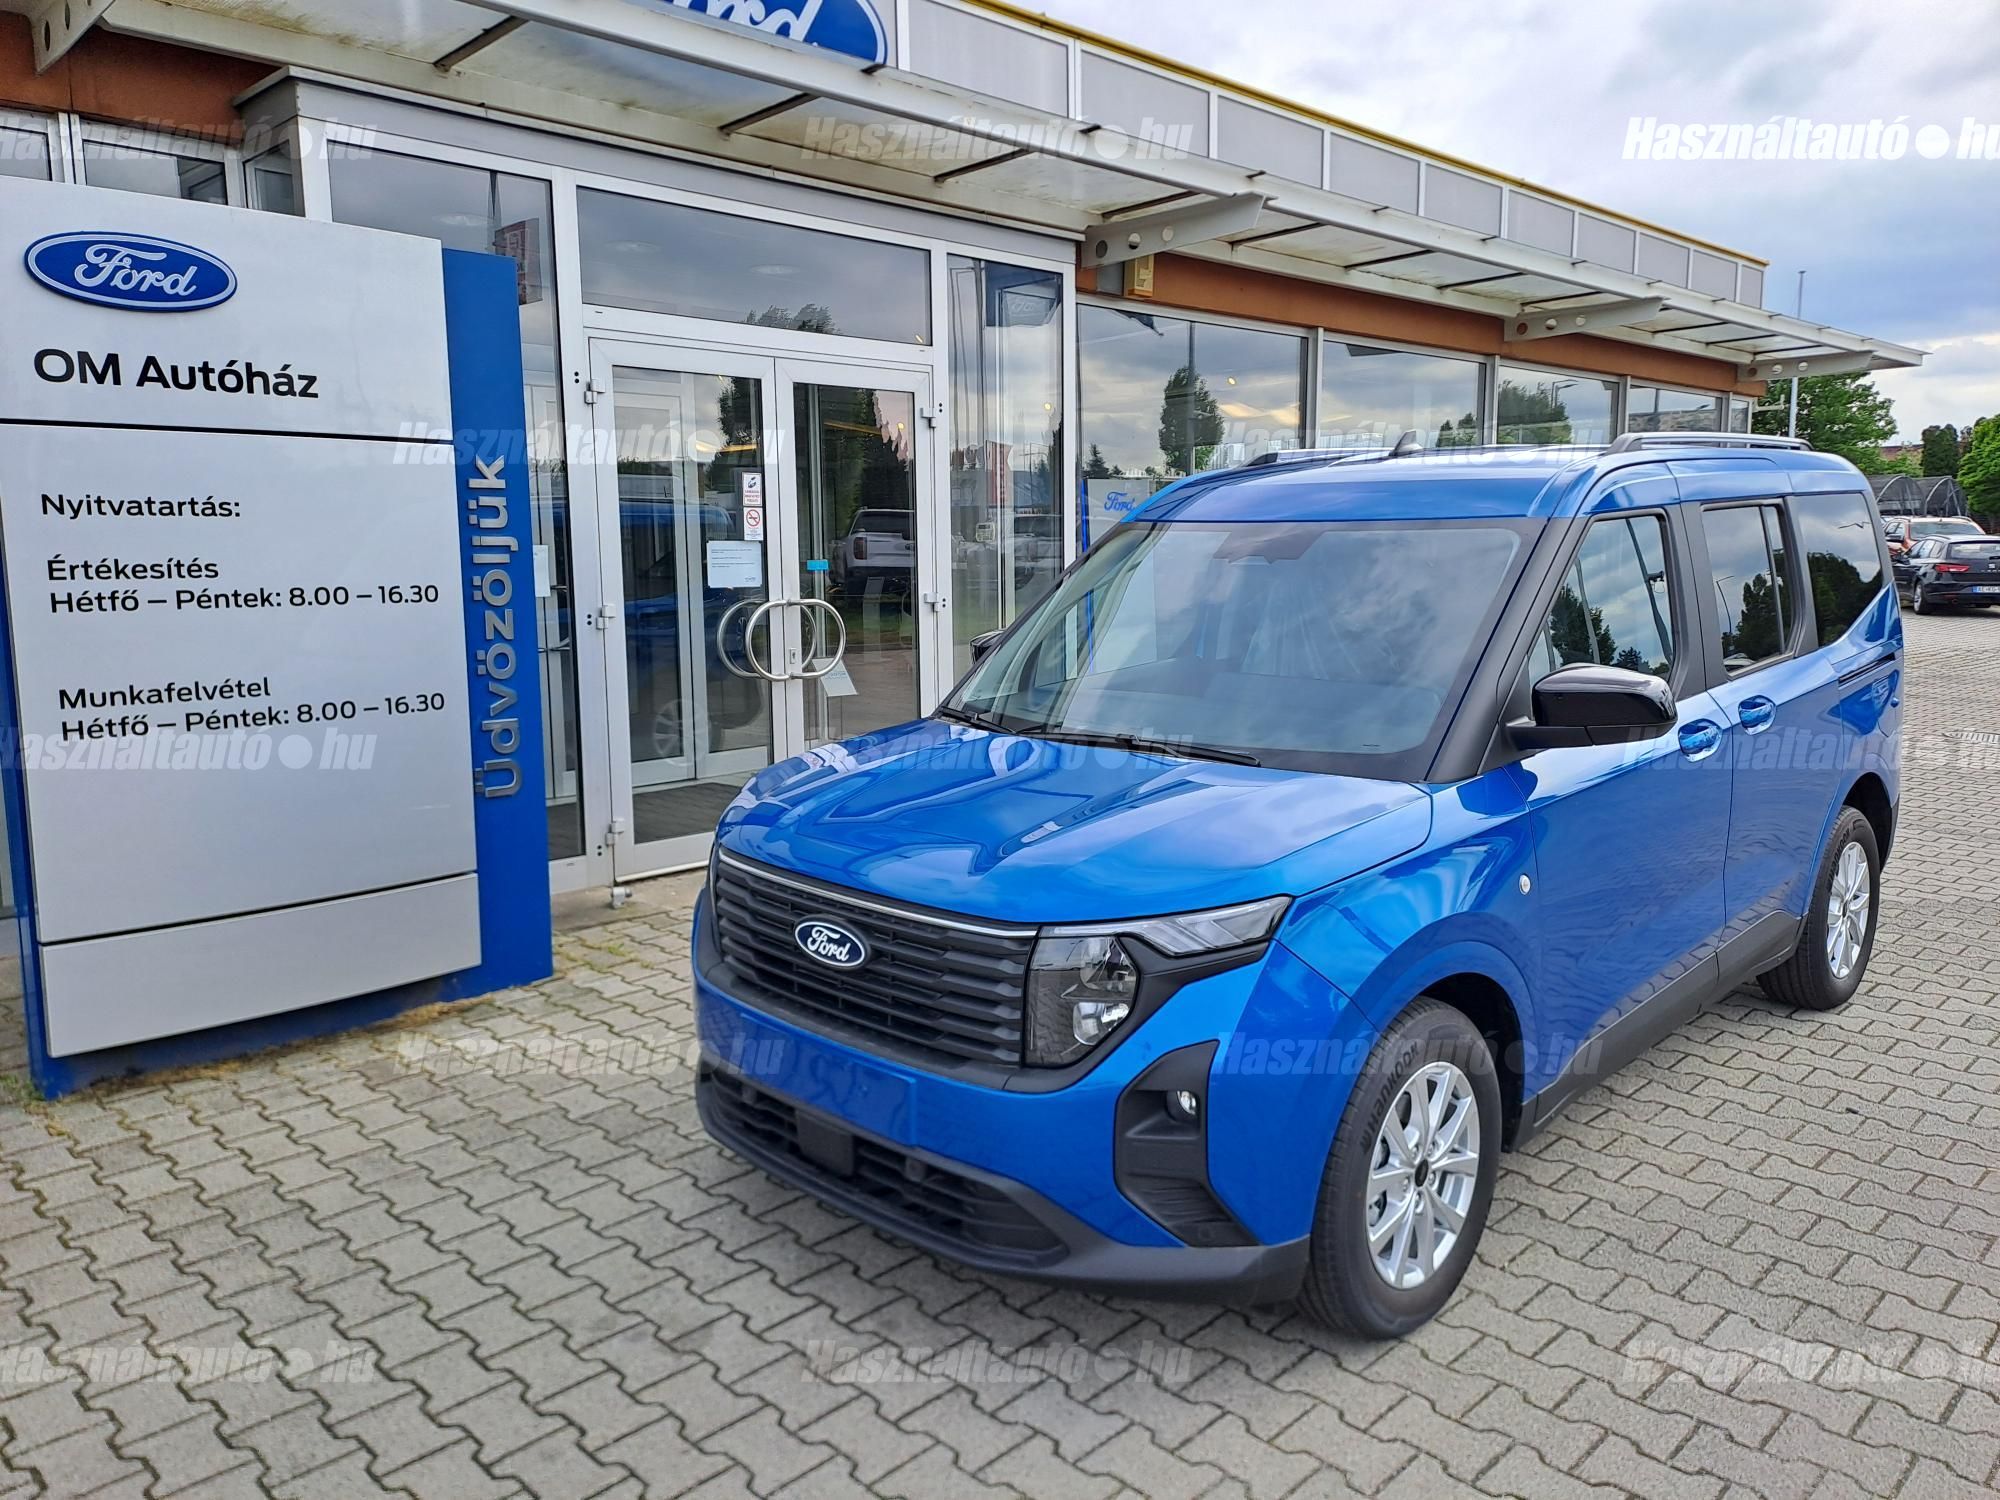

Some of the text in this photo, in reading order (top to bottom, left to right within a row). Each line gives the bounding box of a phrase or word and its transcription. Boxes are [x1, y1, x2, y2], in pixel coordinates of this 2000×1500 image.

[74, 243, 198, 297] Ford
[34, 348, 319, 399] OM Autóház
[41, 493, 241, 520] Nyitvatartás:
[1104, 491, 1136, 511] Ford
[47, 553, 219, 581] Értékesítés
[50, 589, 140, 613] Hétfő
[175, 587, 282, 610] Péntek:
[288, 586, 350, 607] 8.00
[378, 584, 439, 604] 16.30
[467, 454, 522, 798] Üdvözöljük
[58, 676, 271, 710] Munkafelvétel
[61, 714, 149, 742] Hétfő
[185, 705, 290, 732] Péntek:
[296, 700, 356, 723] 8.00
[384, 692, 445, 715] 16.30
[806, 926, 851, 962] Ford
